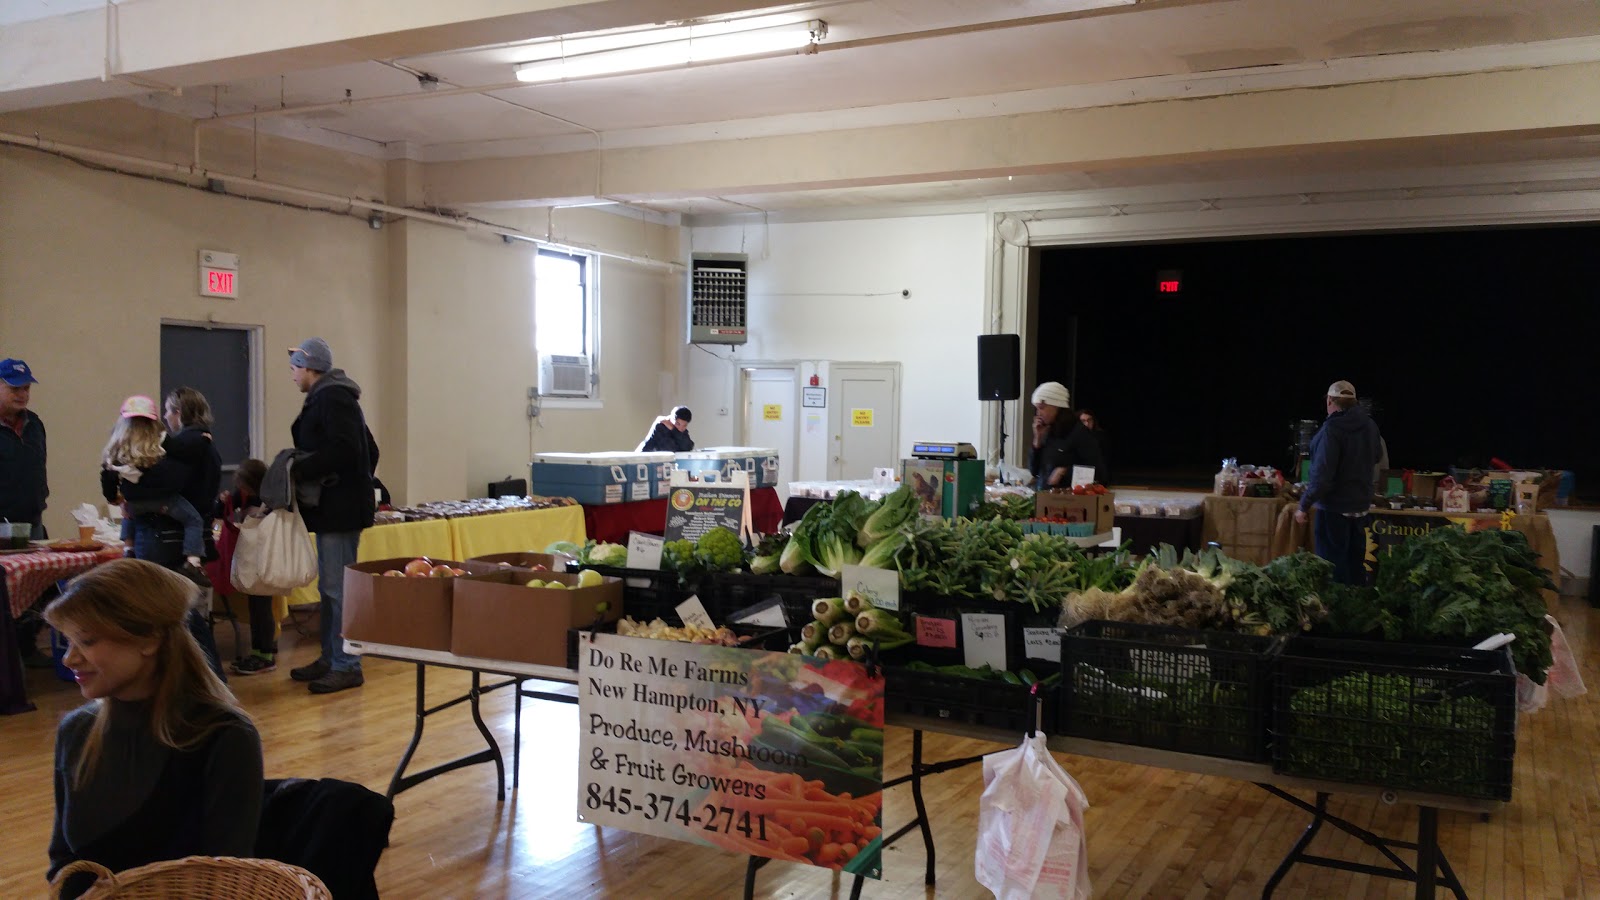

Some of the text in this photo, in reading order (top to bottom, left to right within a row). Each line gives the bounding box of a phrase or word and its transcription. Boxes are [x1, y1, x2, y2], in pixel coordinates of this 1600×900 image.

[209, 271, 234, 294] EXIT
[1160, 281, 1179, 292] EXIT
[695, 498, 742, 508] ON THE GO
[1372, 519, 1435, 537] Granol
[589, 648, 749, 686] Do Re Me Farms
[588, 677, 766, 718] New Hampton, NY
[589, 713, 809, 769] Produce, Mushroom
[590, 747, 766, 800] & Fruit Growers
[586, 782, 769, 842] 845-374-2741
